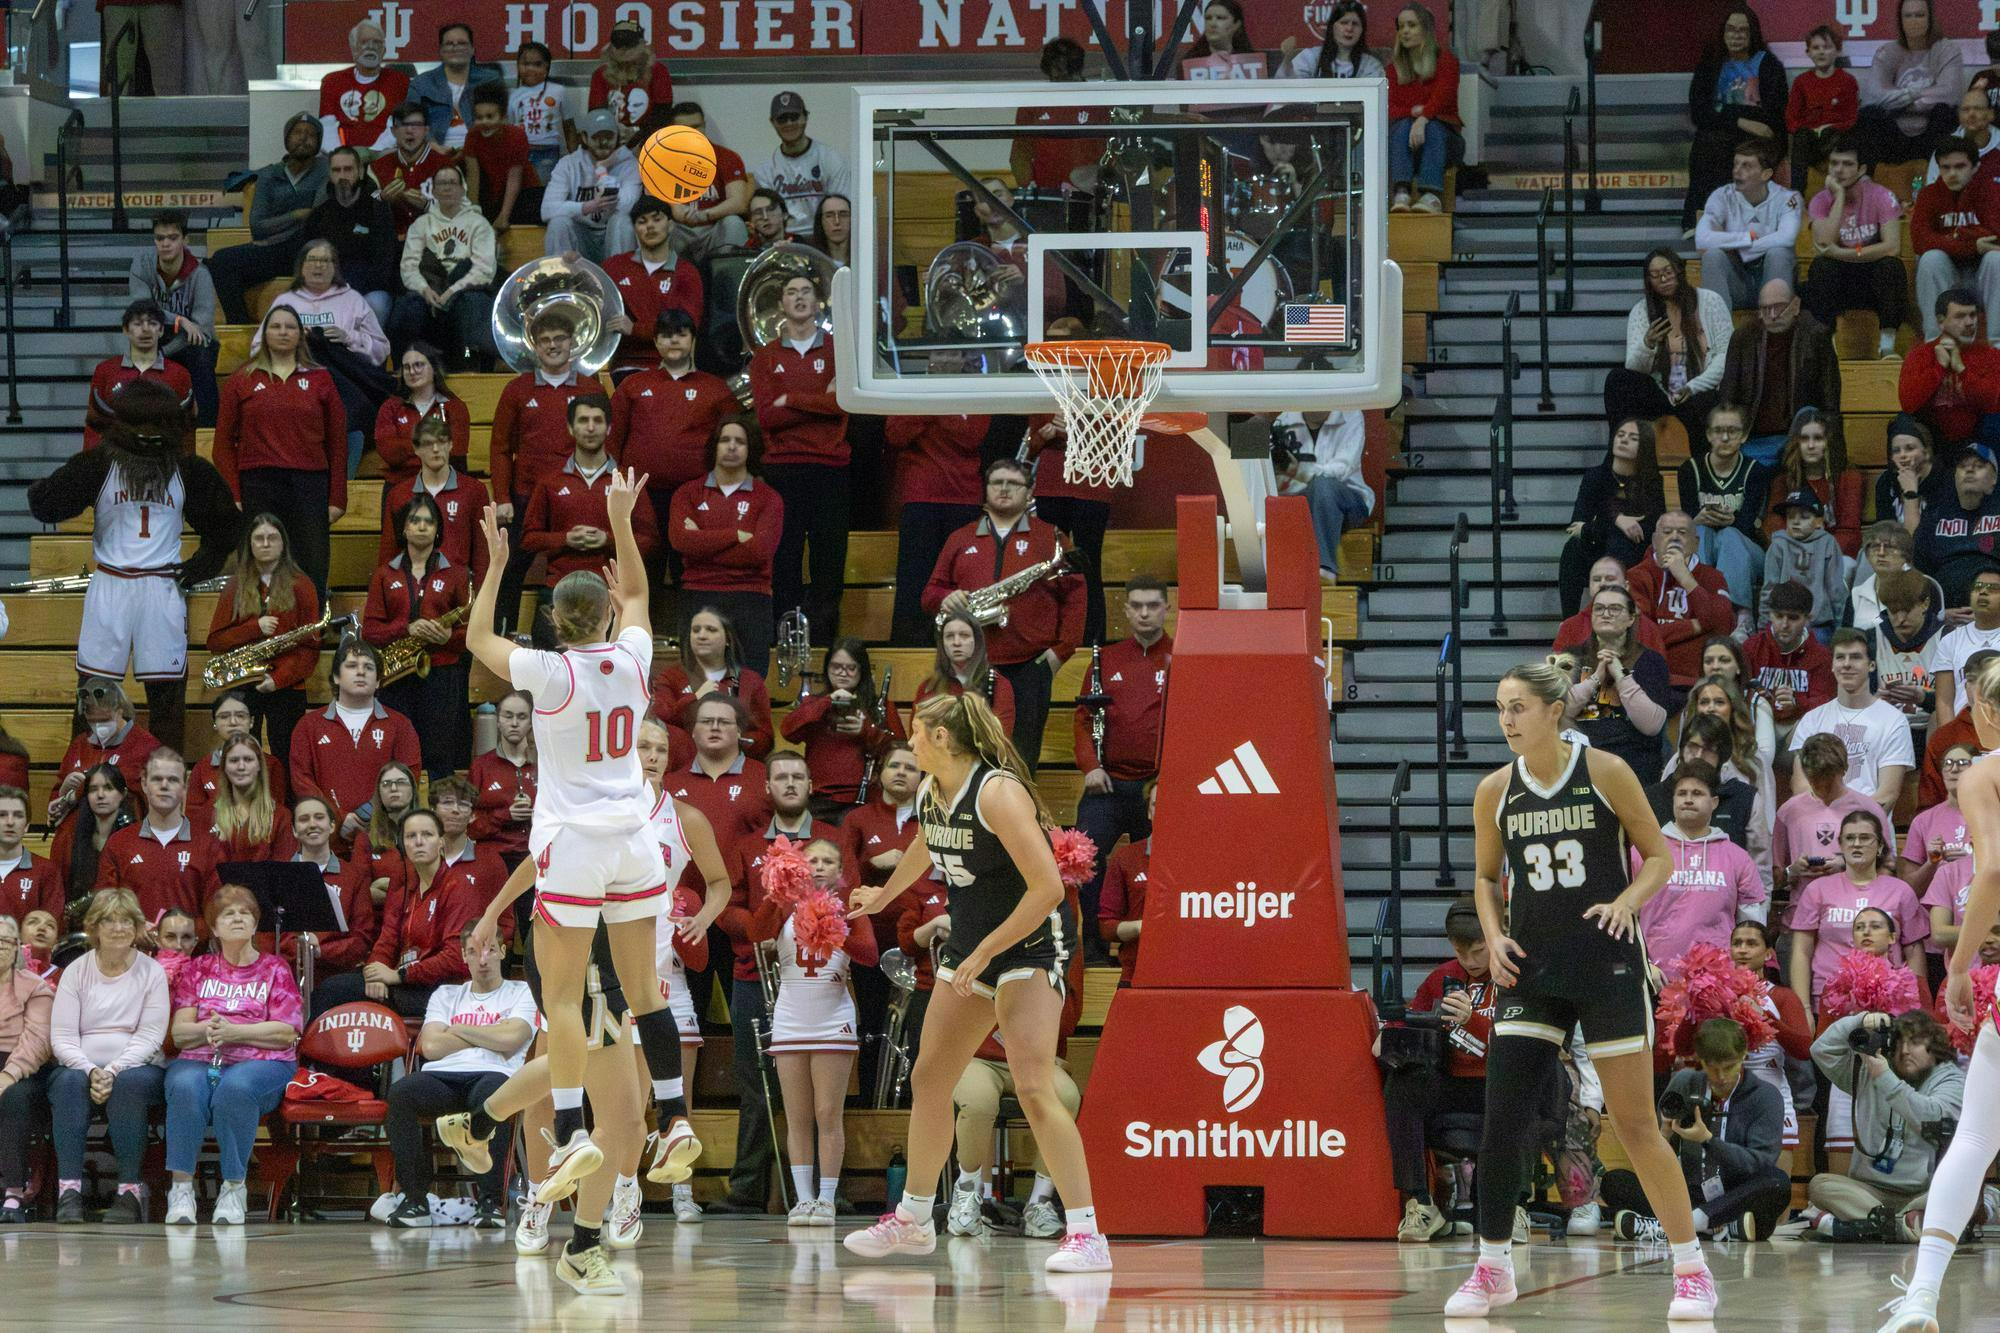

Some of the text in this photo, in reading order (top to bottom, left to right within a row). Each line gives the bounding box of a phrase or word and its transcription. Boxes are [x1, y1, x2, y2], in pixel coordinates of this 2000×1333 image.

[505, 0, 855, 53] HOOSIER
[1190, 62, 1263, 79] BEAT
[123, 195, 163, 207] YOUR
[170, 193, 214, 206] STEP!
[1428, 347, 1448, 362] 14
[1404, 453, 1424, 468] 12
[113, 489, 175, 509] INANA
[138, 504, 151, 538] 1
[1935, 515, 2000, 537] INDIANA
[1375, 565, 1394, 581] 10
[1757, 666, 1809, 692] INDIANA
[1347, 684, 1358, 700] 8
[585, 705, 634, 763] 10
[1507, 804, 1596, 840] PURDUE
[924, 823, 974, 850] PURDUE
[929, 850, 977, 888] 55
[1523, 839, 1587, 892] 33
[1180, 881, 1295, 927] meijer
[200, 979, 268, 1002] INDIANA
[318, 1011, 394, 1034] INDIANA
[1124, 1119, 1346, 1158] Smithville
